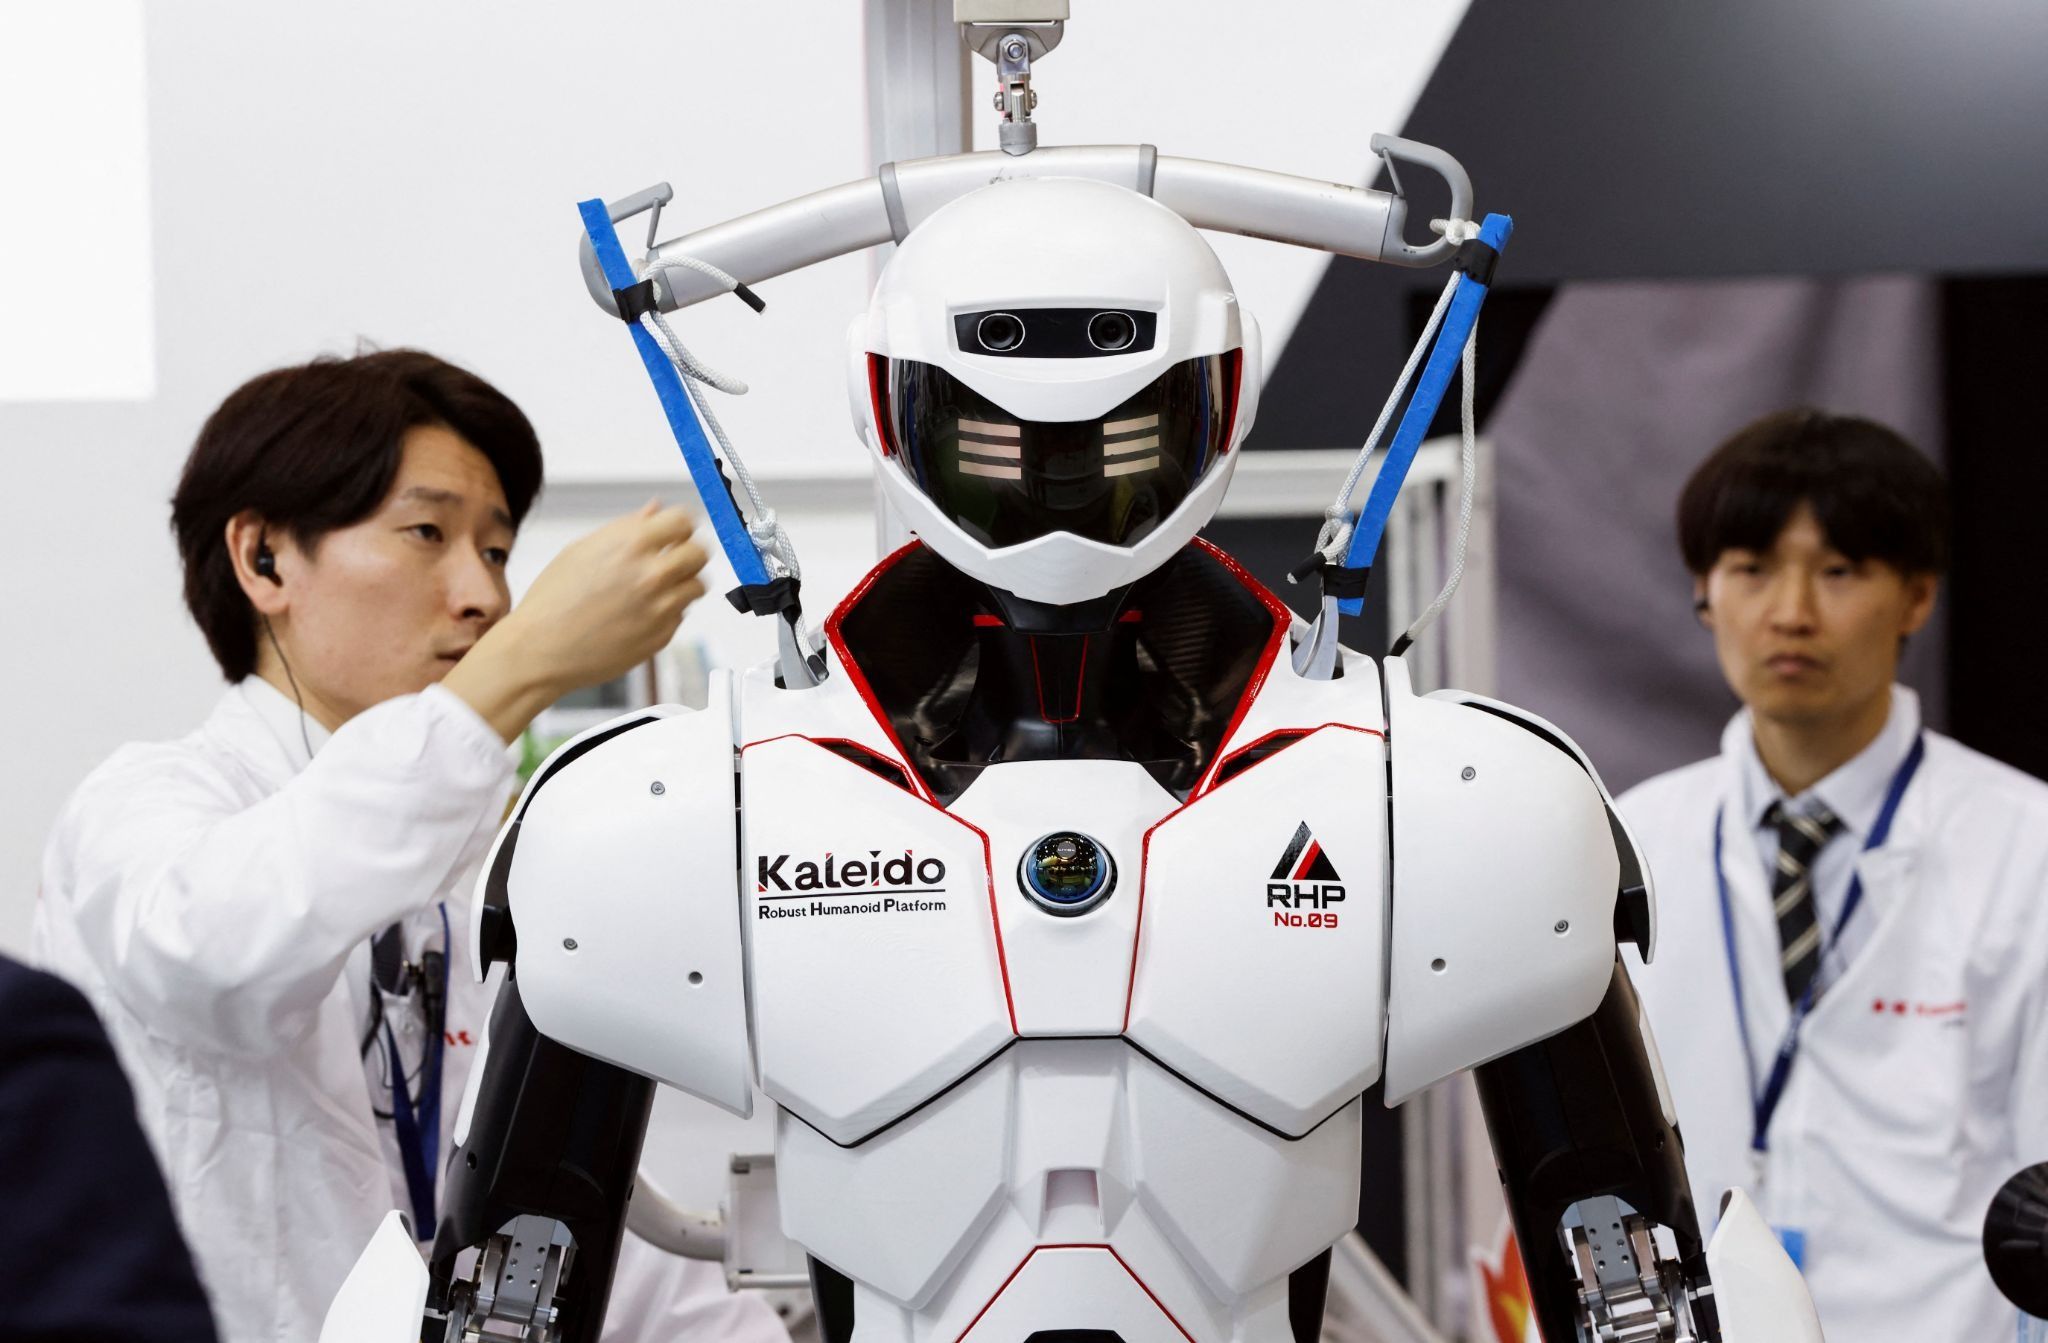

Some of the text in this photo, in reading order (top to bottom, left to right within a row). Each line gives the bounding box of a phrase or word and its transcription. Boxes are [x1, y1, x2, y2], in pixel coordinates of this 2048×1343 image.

[758, 849, 946, 892] Kaleido
[1266, 883, 1346, 909] RHP
[758, 898, 946, 919] Robust Humanoid Platform
[1274, 911, 1338, 929] No.09
